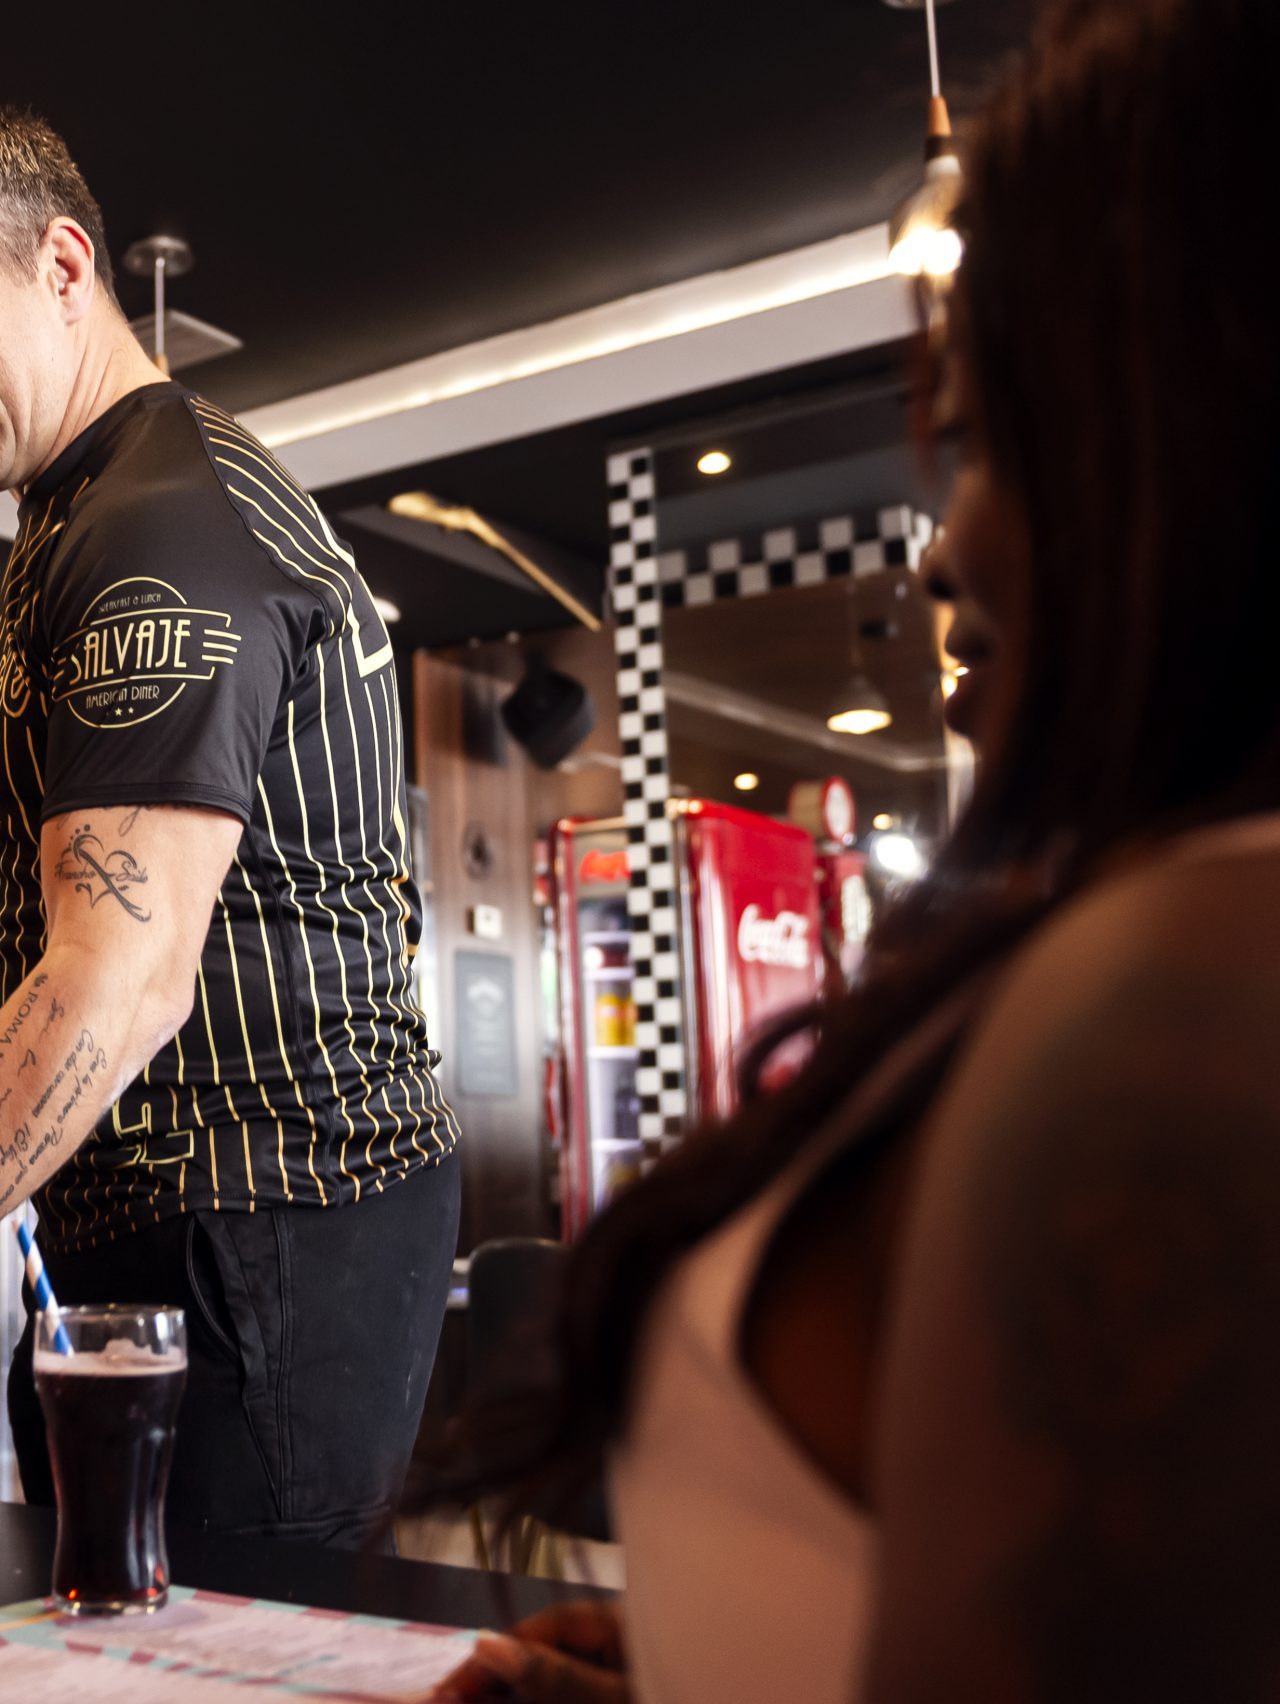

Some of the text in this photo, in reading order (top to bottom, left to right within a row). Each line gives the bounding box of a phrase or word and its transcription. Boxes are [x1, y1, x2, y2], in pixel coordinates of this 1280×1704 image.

[99, 596, 130, 612] EAKFAST
[69, 618, 191, 685] SALVAJE
[86, 685, 160, 709] AMERICAN DINER
